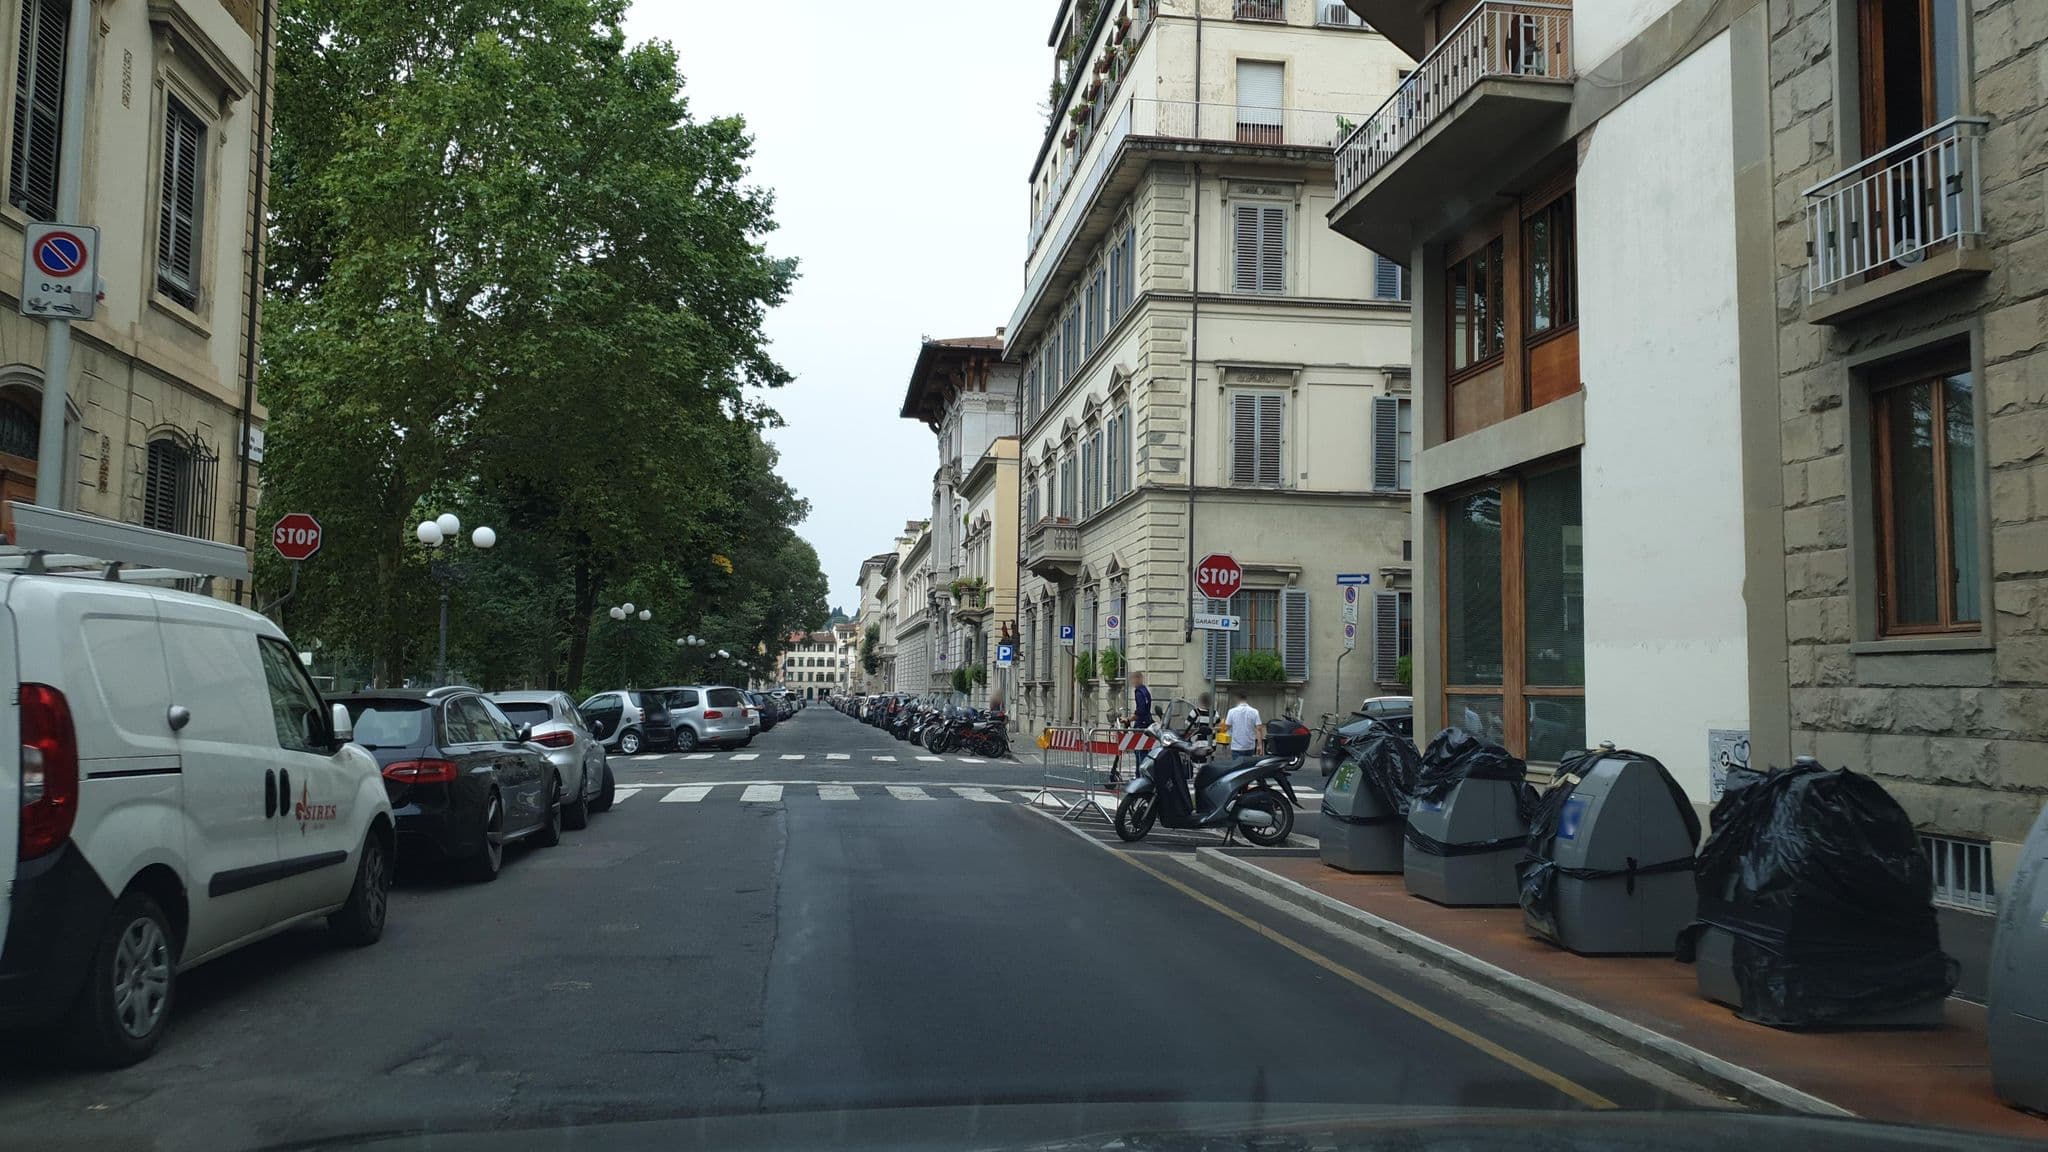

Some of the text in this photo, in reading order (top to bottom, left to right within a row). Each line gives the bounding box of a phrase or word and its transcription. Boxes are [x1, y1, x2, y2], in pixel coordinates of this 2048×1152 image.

[276, 527, 318, 545] STOP
[1199, 567, 1240, 586] STOP
[1195, 618, 1220, 626] GARAGE
[1062, 626, 1071, 638] P
[1000, 646, 1011, 660] P
